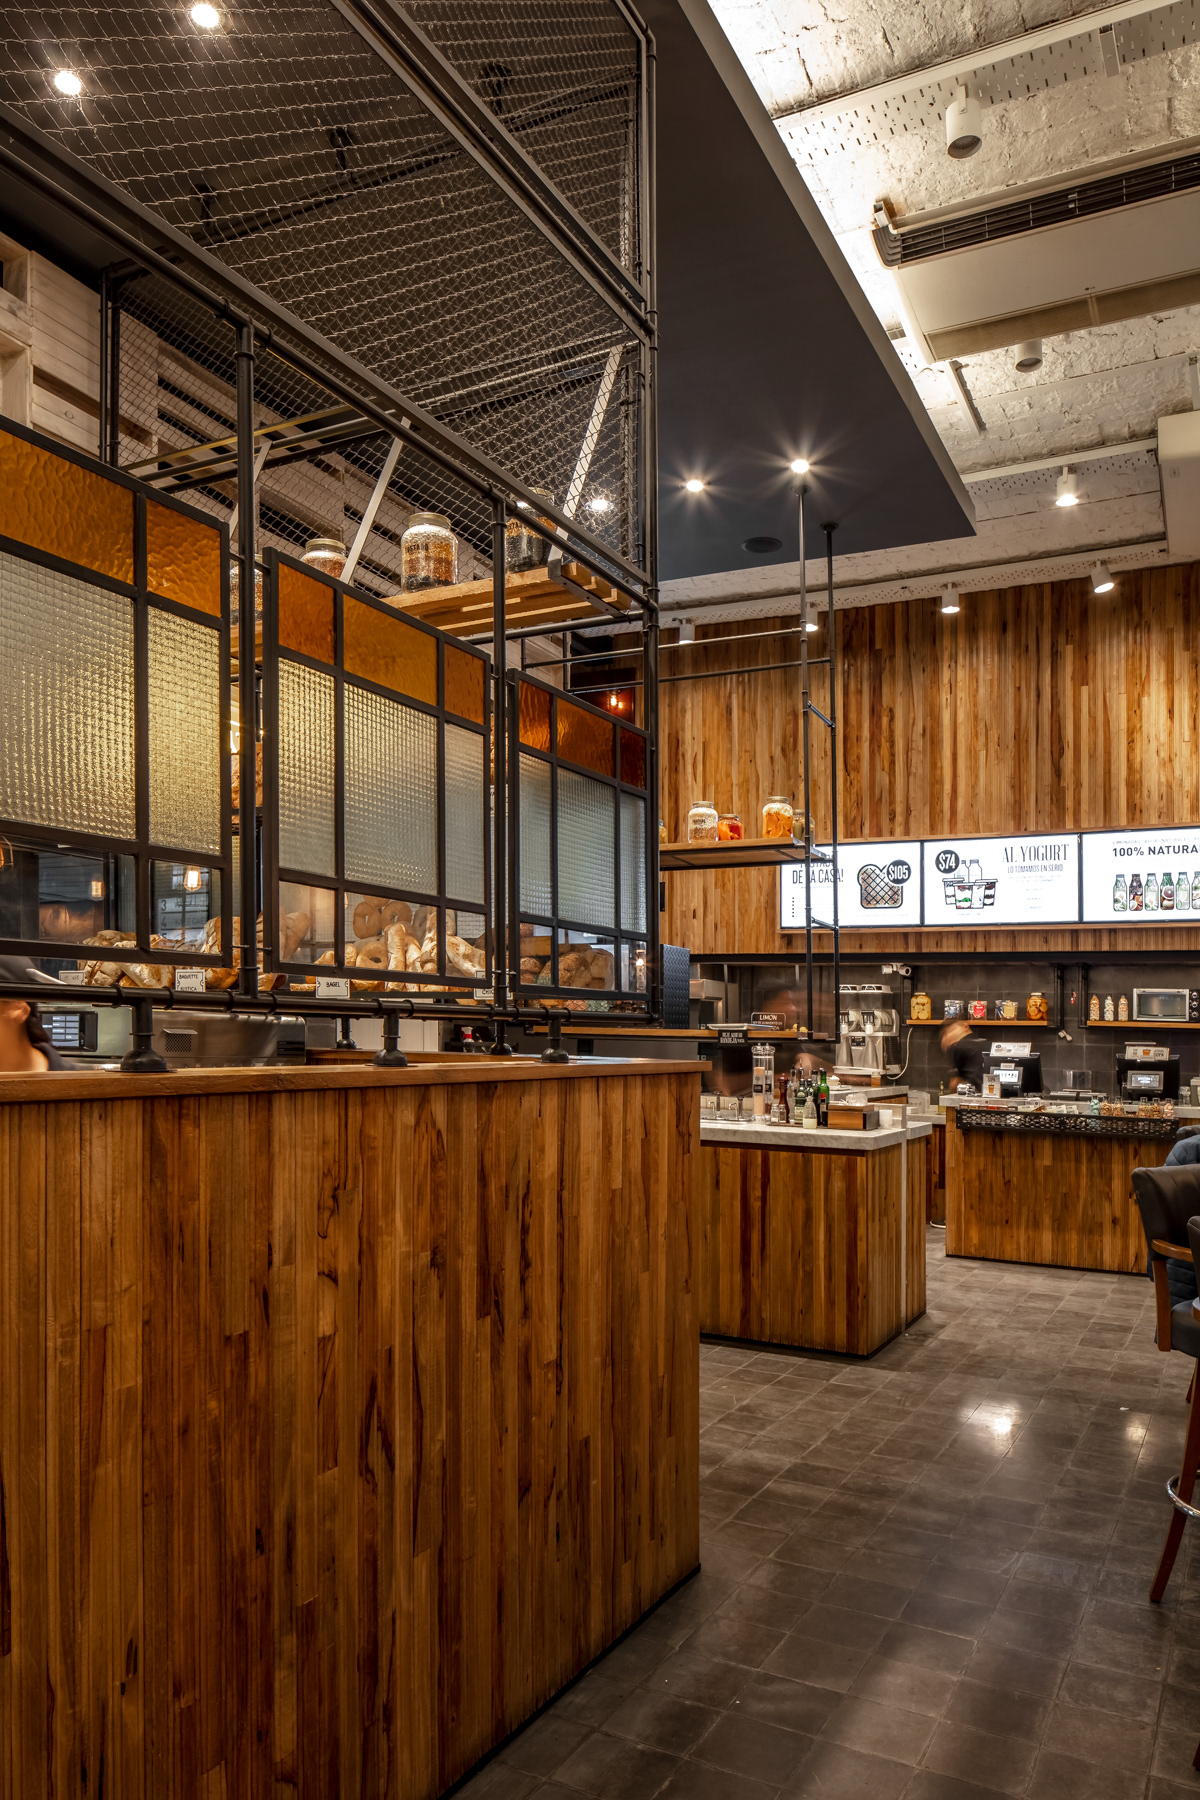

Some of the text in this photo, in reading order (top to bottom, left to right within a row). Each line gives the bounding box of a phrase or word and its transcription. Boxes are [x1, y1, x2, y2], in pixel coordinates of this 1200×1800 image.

[1002, 843, 1069, 863] AL YOGURT
[1112, 844, 1200, 857] 100% NATURA
[939, 853, 956, 871] $74
[1007, 863, 1064, 873] LO TOMAMOS EN SERIO
[792, 870, 803, 884] DE
[888, 864, 909, 881] $105
[160, 899, 167, 911] 3
[160, 917, 167, 927] 4
